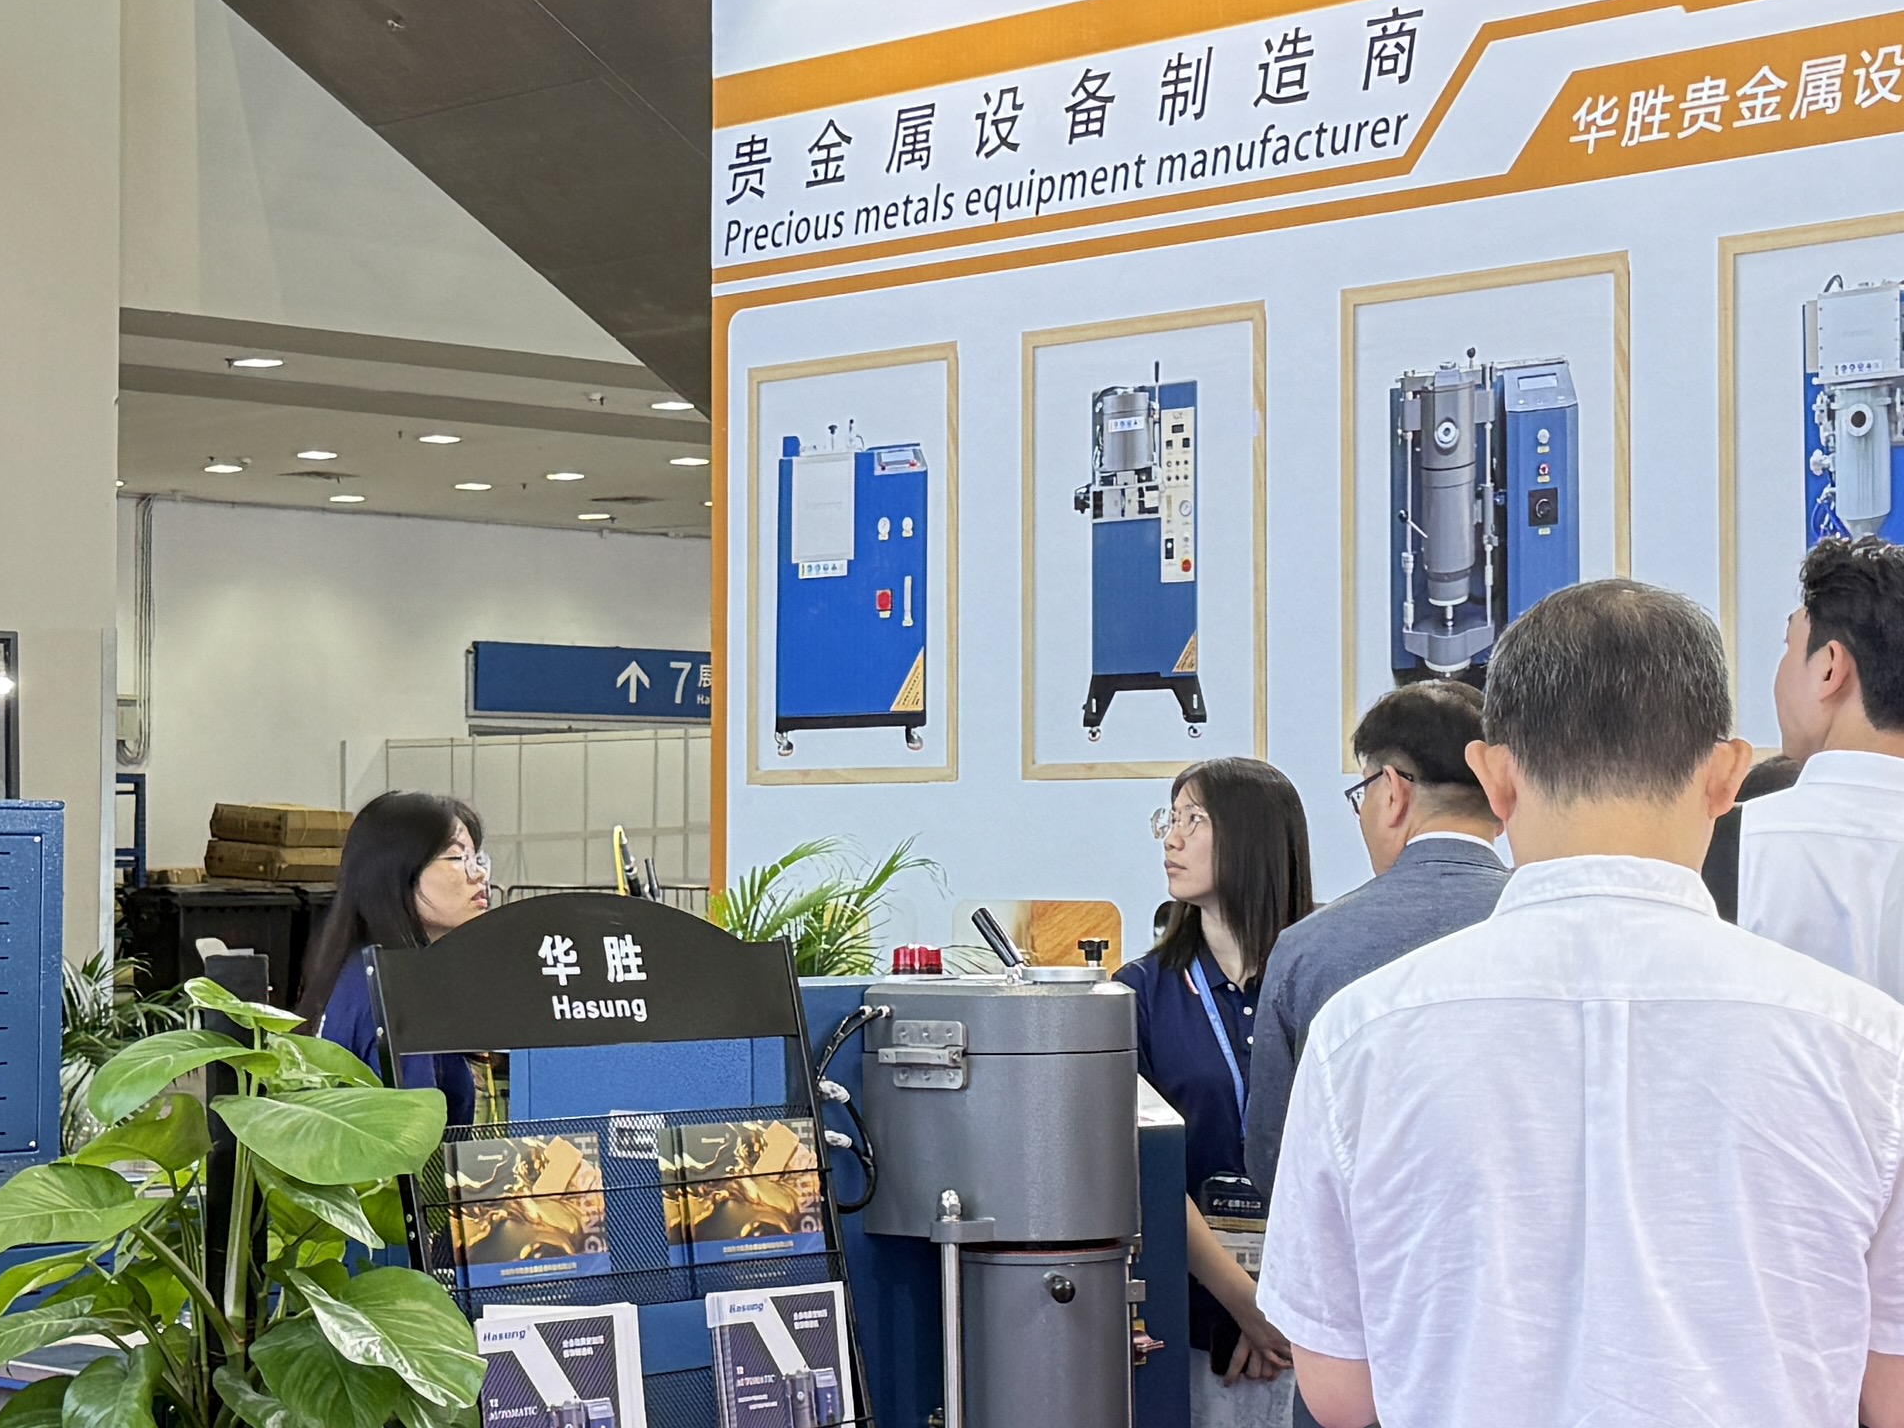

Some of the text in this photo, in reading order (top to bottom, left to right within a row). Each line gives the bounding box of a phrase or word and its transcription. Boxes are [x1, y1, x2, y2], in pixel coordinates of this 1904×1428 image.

[724, 6, 1423, 205] 贵金属设备制造商
[724, 110, 1409, 257] Precious metals equipment manufacturer
[669, 661, 692, 704] 7
[538, 934, 647, 986] 华胜
[552, 991, 648, 1022] Hasung
[483, 1329, 527, 1343] Hasung
